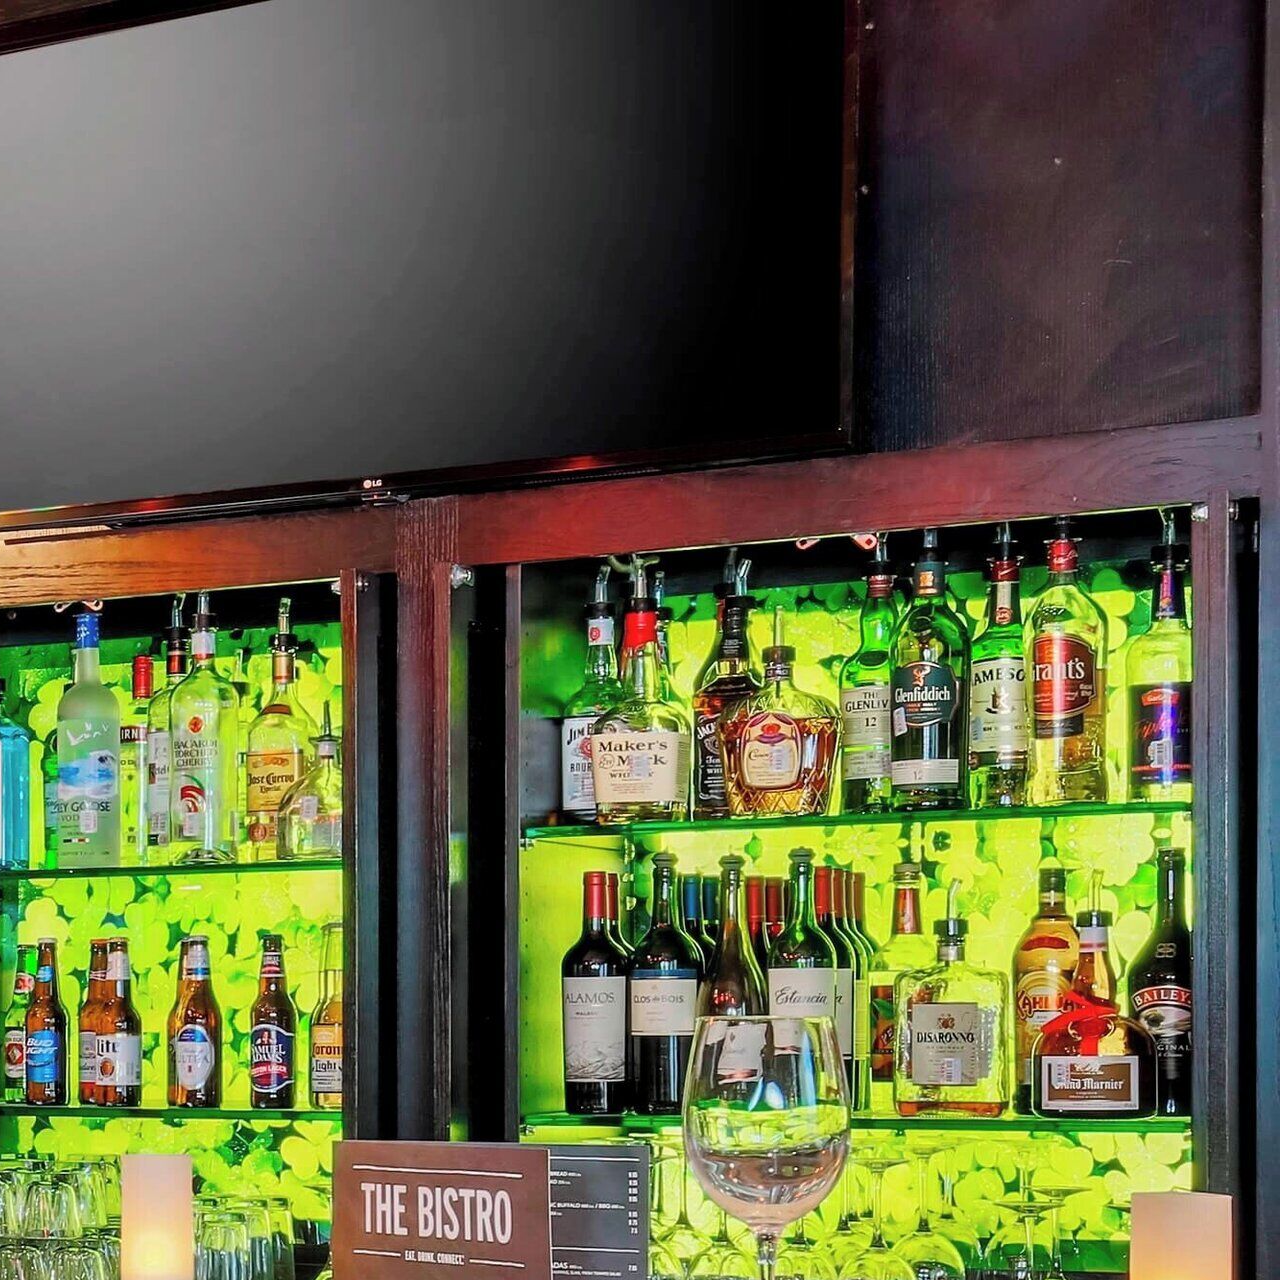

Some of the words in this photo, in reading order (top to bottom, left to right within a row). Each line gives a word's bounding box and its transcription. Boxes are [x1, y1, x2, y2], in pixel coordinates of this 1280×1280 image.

[895, 686, 951, 704] Glenfiddich
[864, 717, 877, 727] 12
[567, 727, 585, 746] JIM
[598, 740, 668, 753] Maker's
[248, 773, 266, 787] Jose
[265, 773, 295, 786] Cuervo
[565, 991, 615, 1005] ALAMOS
[633, 994, 651, 1004] CLOS
[661, 994, 684, 1004] BOIS
[774, 985, 827, 1005] Estancia
[27, 1037, 54, 1048] BUD
[916, 1031, 975, 1045] DISARONNO
[96, 1038, 118, 1057] Lite
[314, 1060, 337, 1072] Light
[1081, 1077, 1125, 1091] Marnier
[360, 1182, 408, 1236] THE
[418, 1185, 513, 1245] BISTRO
